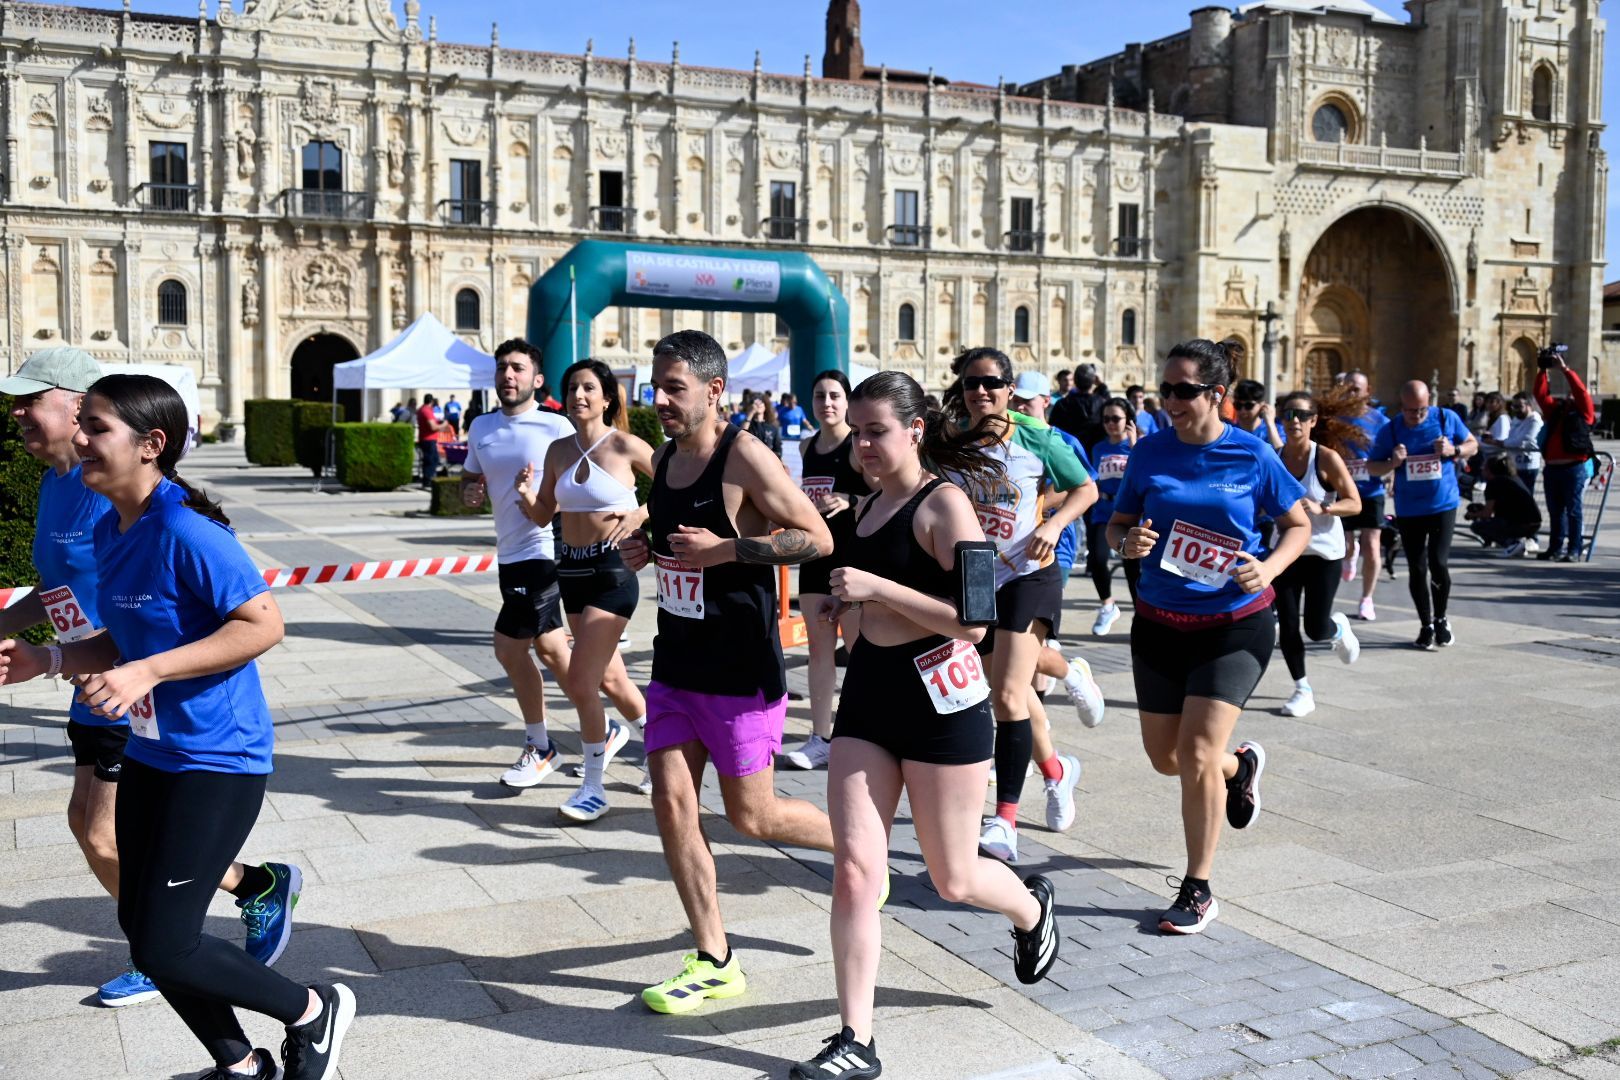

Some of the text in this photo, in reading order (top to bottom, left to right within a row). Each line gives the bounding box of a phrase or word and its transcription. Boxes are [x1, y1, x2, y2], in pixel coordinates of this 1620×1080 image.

[658, 256, 675, 267] DE
[676, 258, 731, 271] CASTILLA
[732, 262, 740, 271] Y
[742, 263, 775, 273] LEÓN
[746, 278, 773, 288] Plena
[1409, 461, 1440, 474] 1253
[1176, 524, 1186, 532] DÍA
[1194, 530, 1218, 542] CASTILLA
[1222, 540, 1238, 548] LEÓN
[570, 543, 598, 560] NIKE
[1171, 536, 1235, 574] 1027
[55, 590, 69, 599] LEÓN
[657, 570, 700, 602] 1117
[135, 593, 152, 601] LEÓN
[50, 602, 88, 632] 62
[920, 657, 932, 668] DÍA
[933, 652, 942, 661] DE
